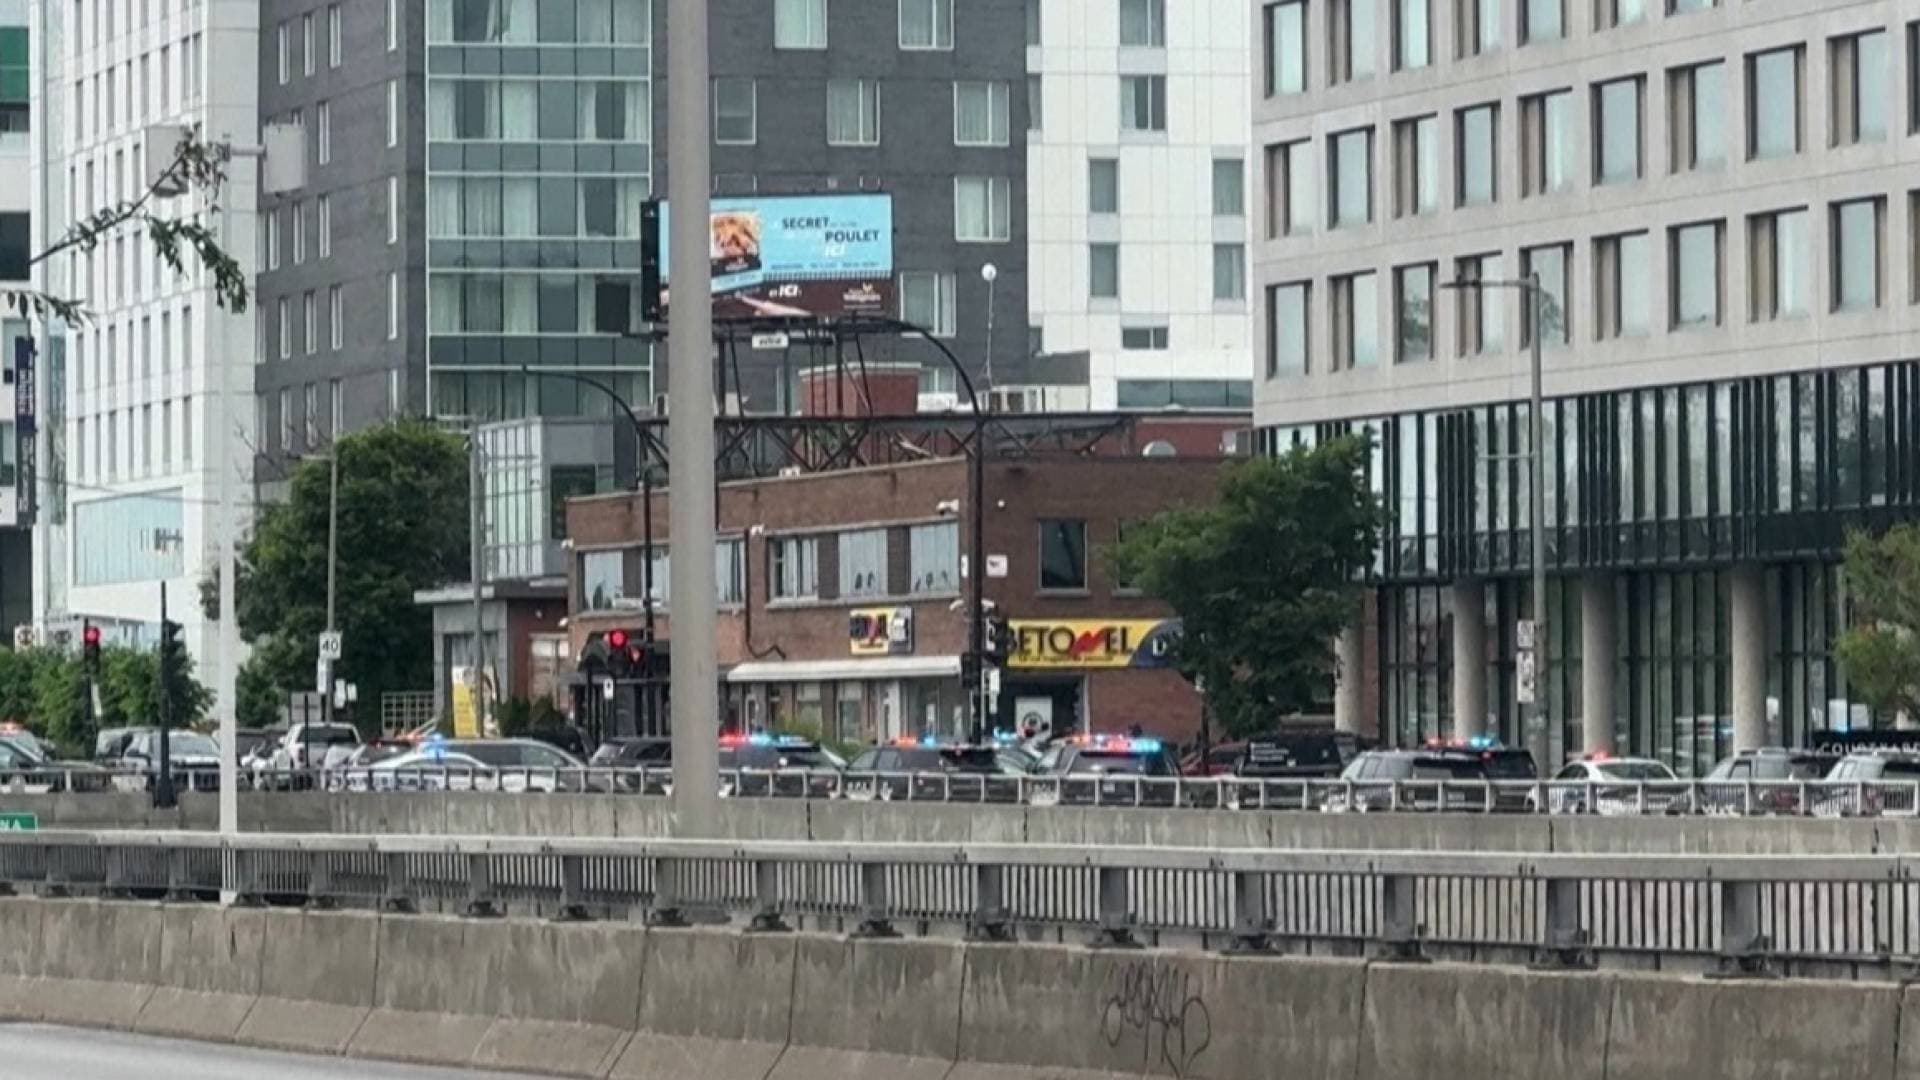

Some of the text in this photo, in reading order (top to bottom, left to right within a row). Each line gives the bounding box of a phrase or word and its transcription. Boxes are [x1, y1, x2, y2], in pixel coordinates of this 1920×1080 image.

[783, 216, 829, 229] SECRET
[825, 230, 879, 242] POULET
[322, 638, 339, 651] 40
